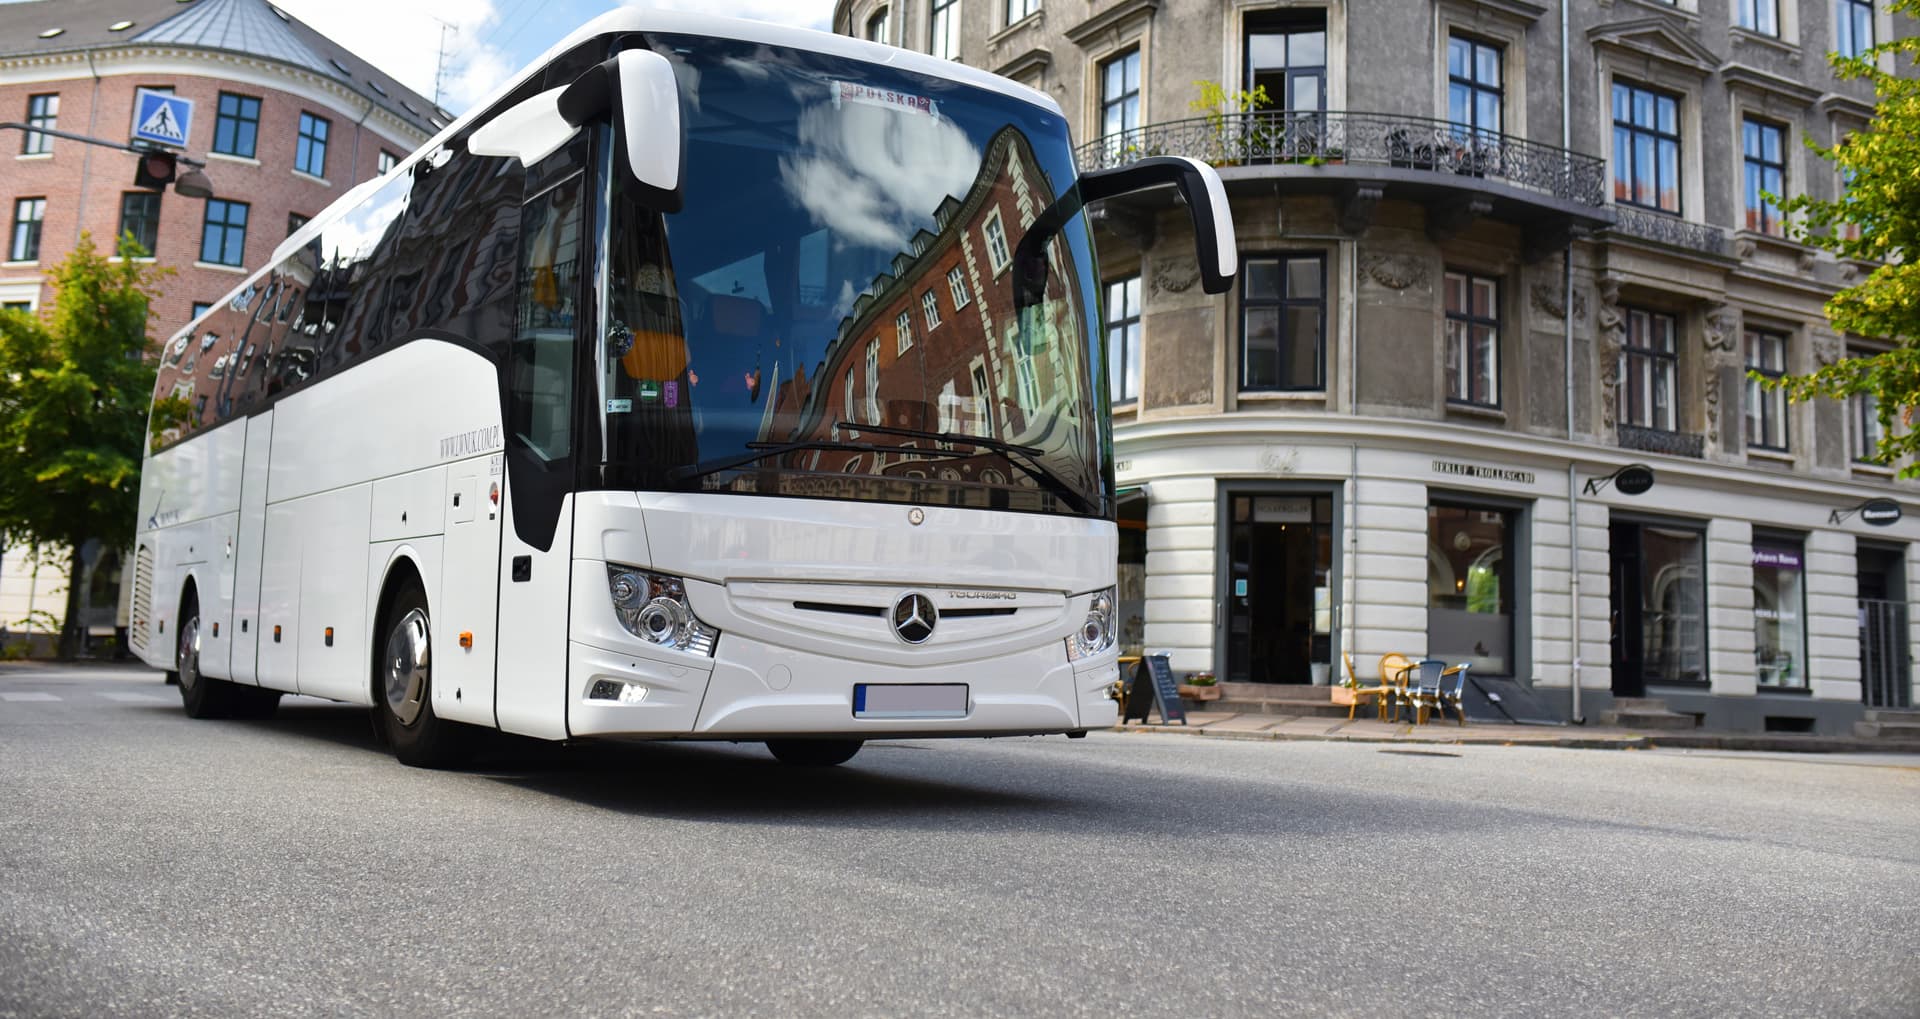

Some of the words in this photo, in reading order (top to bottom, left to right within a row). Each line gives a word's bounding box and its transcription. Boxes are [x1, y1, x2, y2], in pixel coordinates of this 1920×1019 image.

[855, 87, 916, 107] POLSKA
[1432, 460, 1466, 476] HERLUF
[947, 590, 1017, 600] TOURISMO
